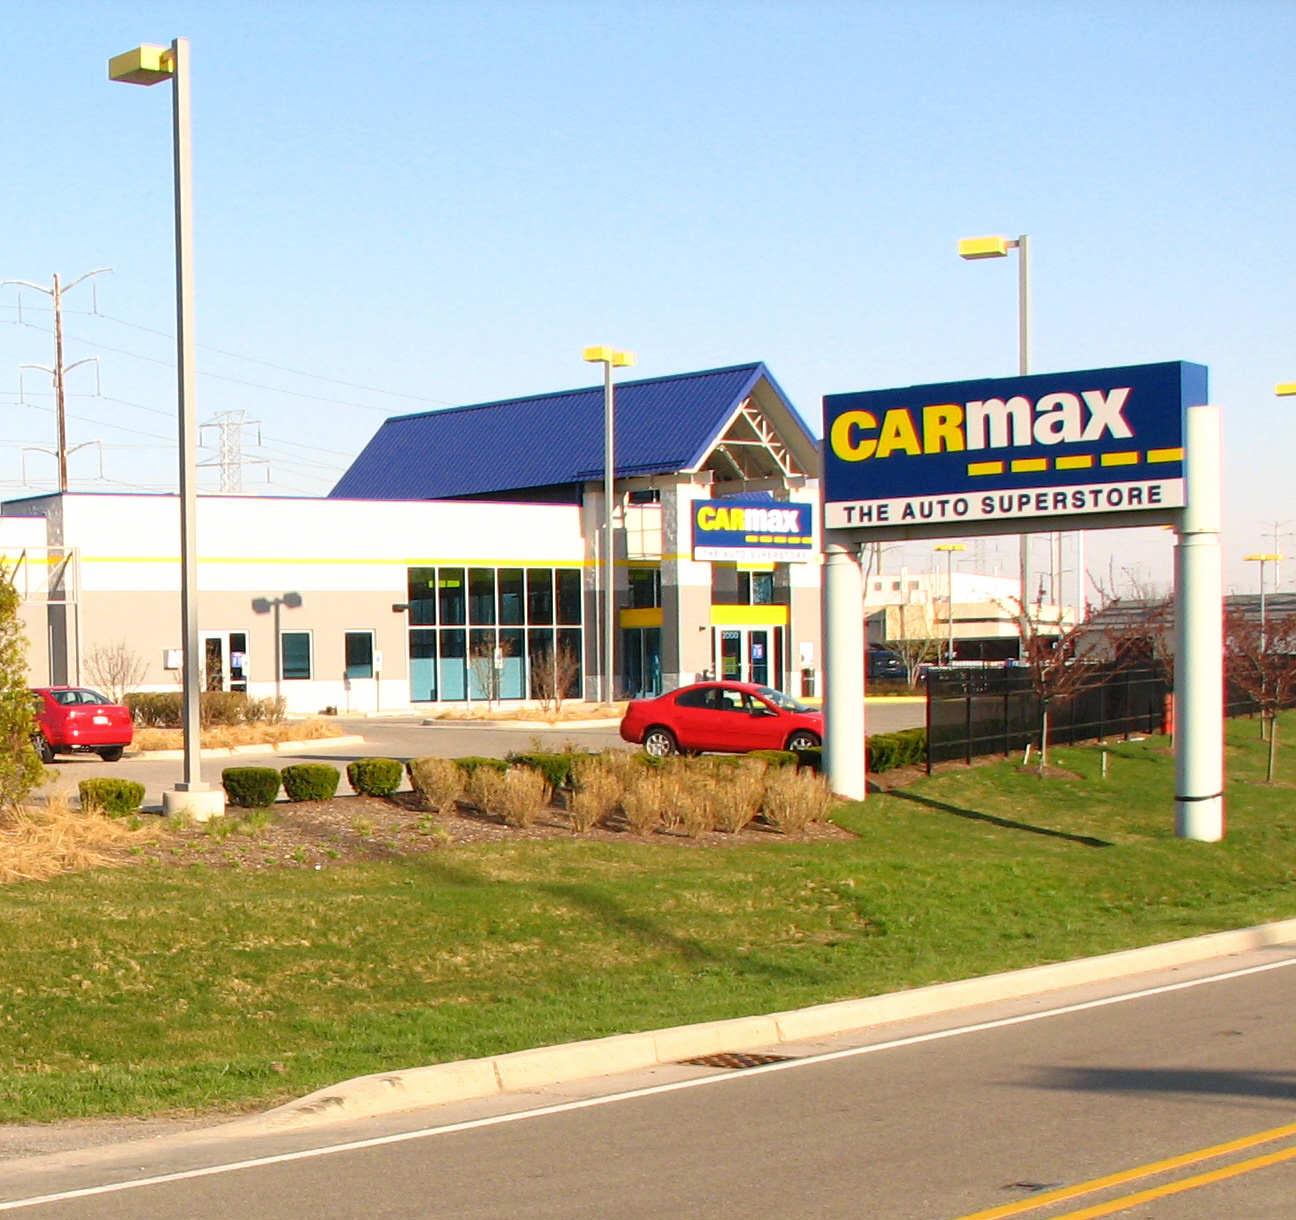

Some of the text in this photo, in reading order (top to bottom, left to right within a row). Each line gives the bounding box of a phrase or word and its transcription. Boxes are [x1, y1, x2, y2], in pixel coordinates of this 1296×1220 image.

[830, 387, 1134, 463] CARmax
[697, 506, 800, 533] CARmax
[843, 485, 1163, 524] THE AUTO SUPERSTORE
